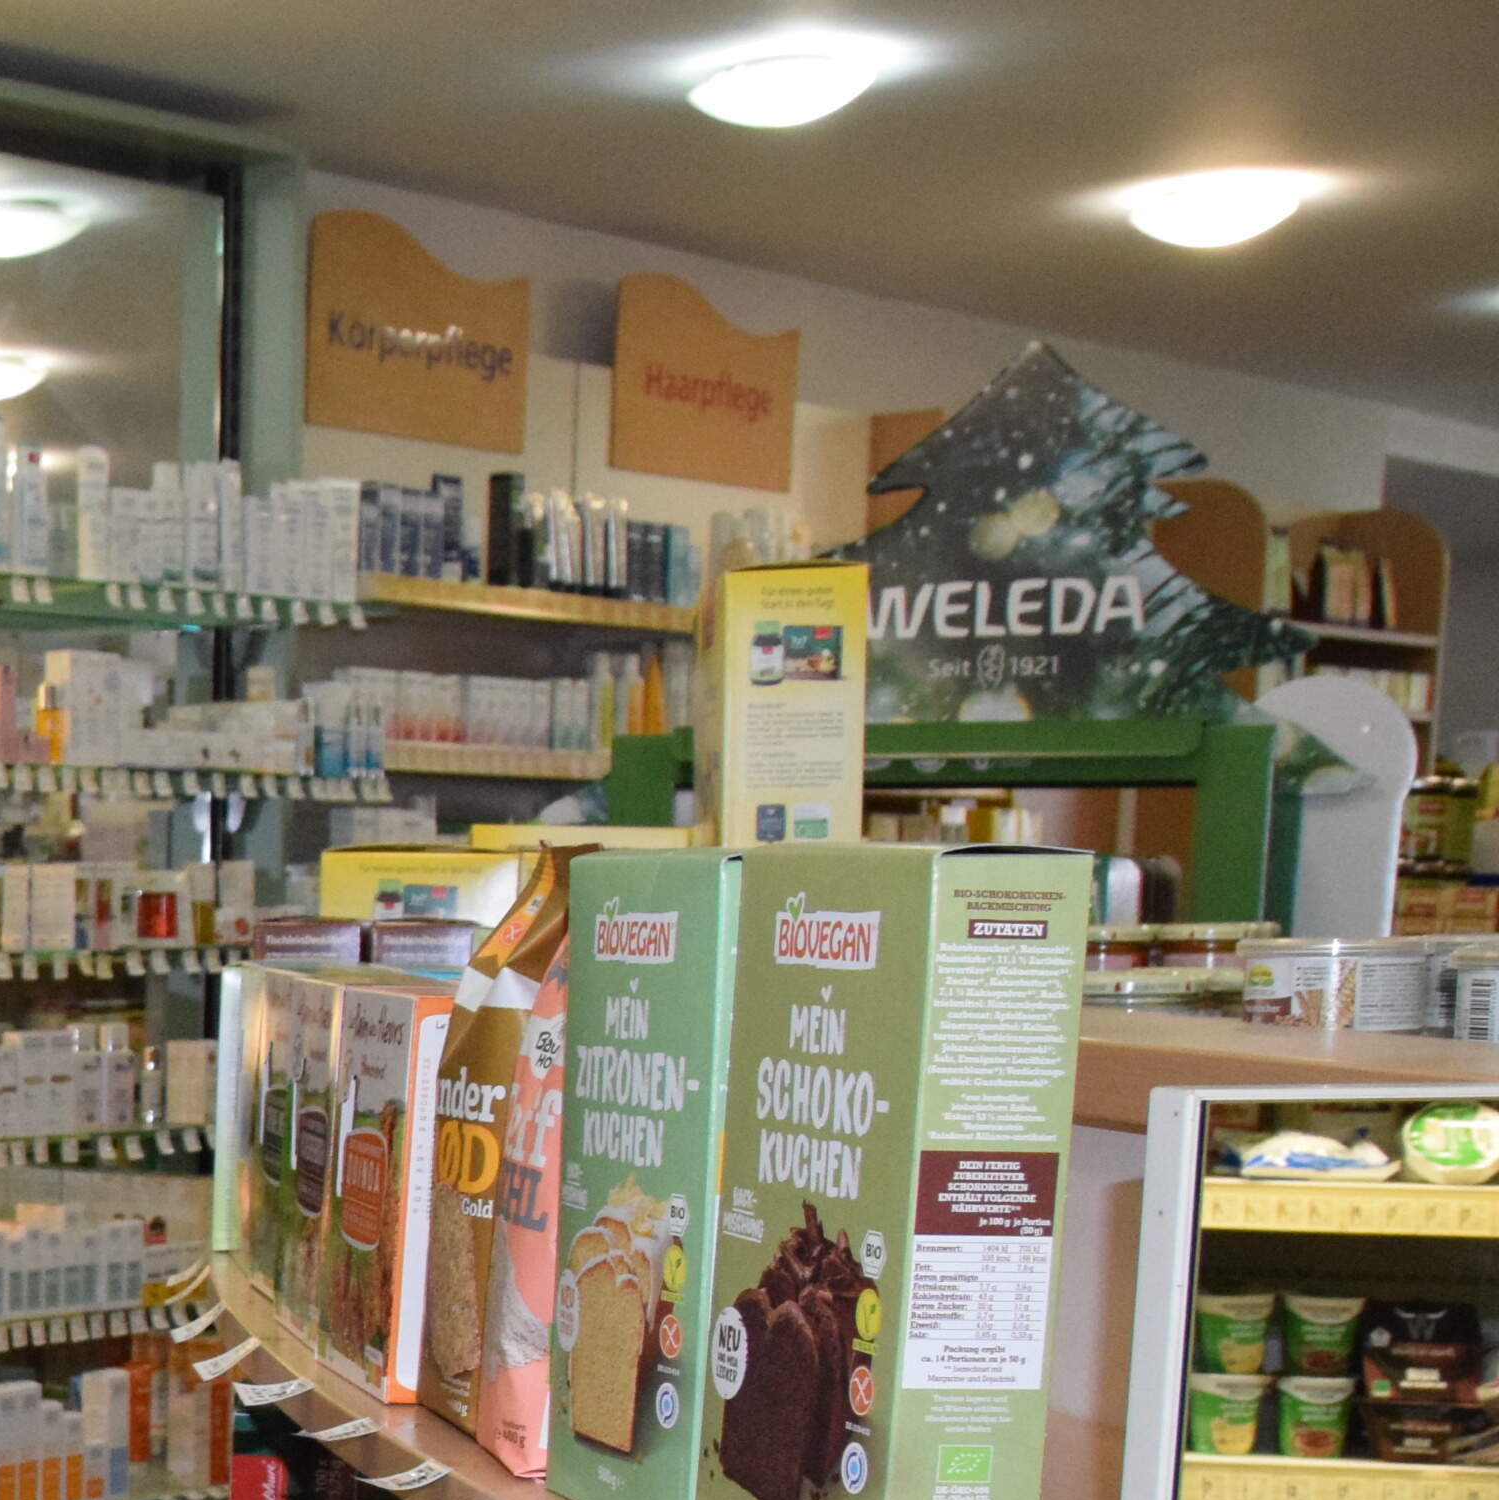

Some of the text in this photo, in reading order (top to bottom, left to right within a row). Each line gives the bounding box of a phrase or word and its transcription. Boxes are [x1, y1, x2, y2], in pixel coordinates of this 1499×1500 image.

[643, 362, 773, 423] Haarpflege
[867, 575, 1147, 639] WELEDA
[928, 656, 1058, 679] Seit 1921
[966, 901, 1052, 913] BACKMISCHUNG
[973, 922, 1044, 937] ZUTATEN
[596, 920, 672, 957] BIOVEGAN
[777, 918, 872, 963] BIOVEGAN
[604, 995, 650, 1041] MEIN
[789, 1003, 846, 1055] MEIN
[436, 1065, 507, 1123] nder
[575, 1044, 700, 1113] ZITRONEN-
[755, 1056, 890, 1137] SCHOKO-
[437, 1119, 501, 1195] ØD
[582, 1108, 665, 1168] KUCHEN
[757, 1128, 862, 1201] KUCHEN
[462, 1198, 494, 1220] Gold
[670, 1205, 686, 1220] BIO
[723, 1211, 764, 1241] MISCHUNG
[865, 1243, 882, 1260] BIO
[718, 1323, 741, 1351] NEU
